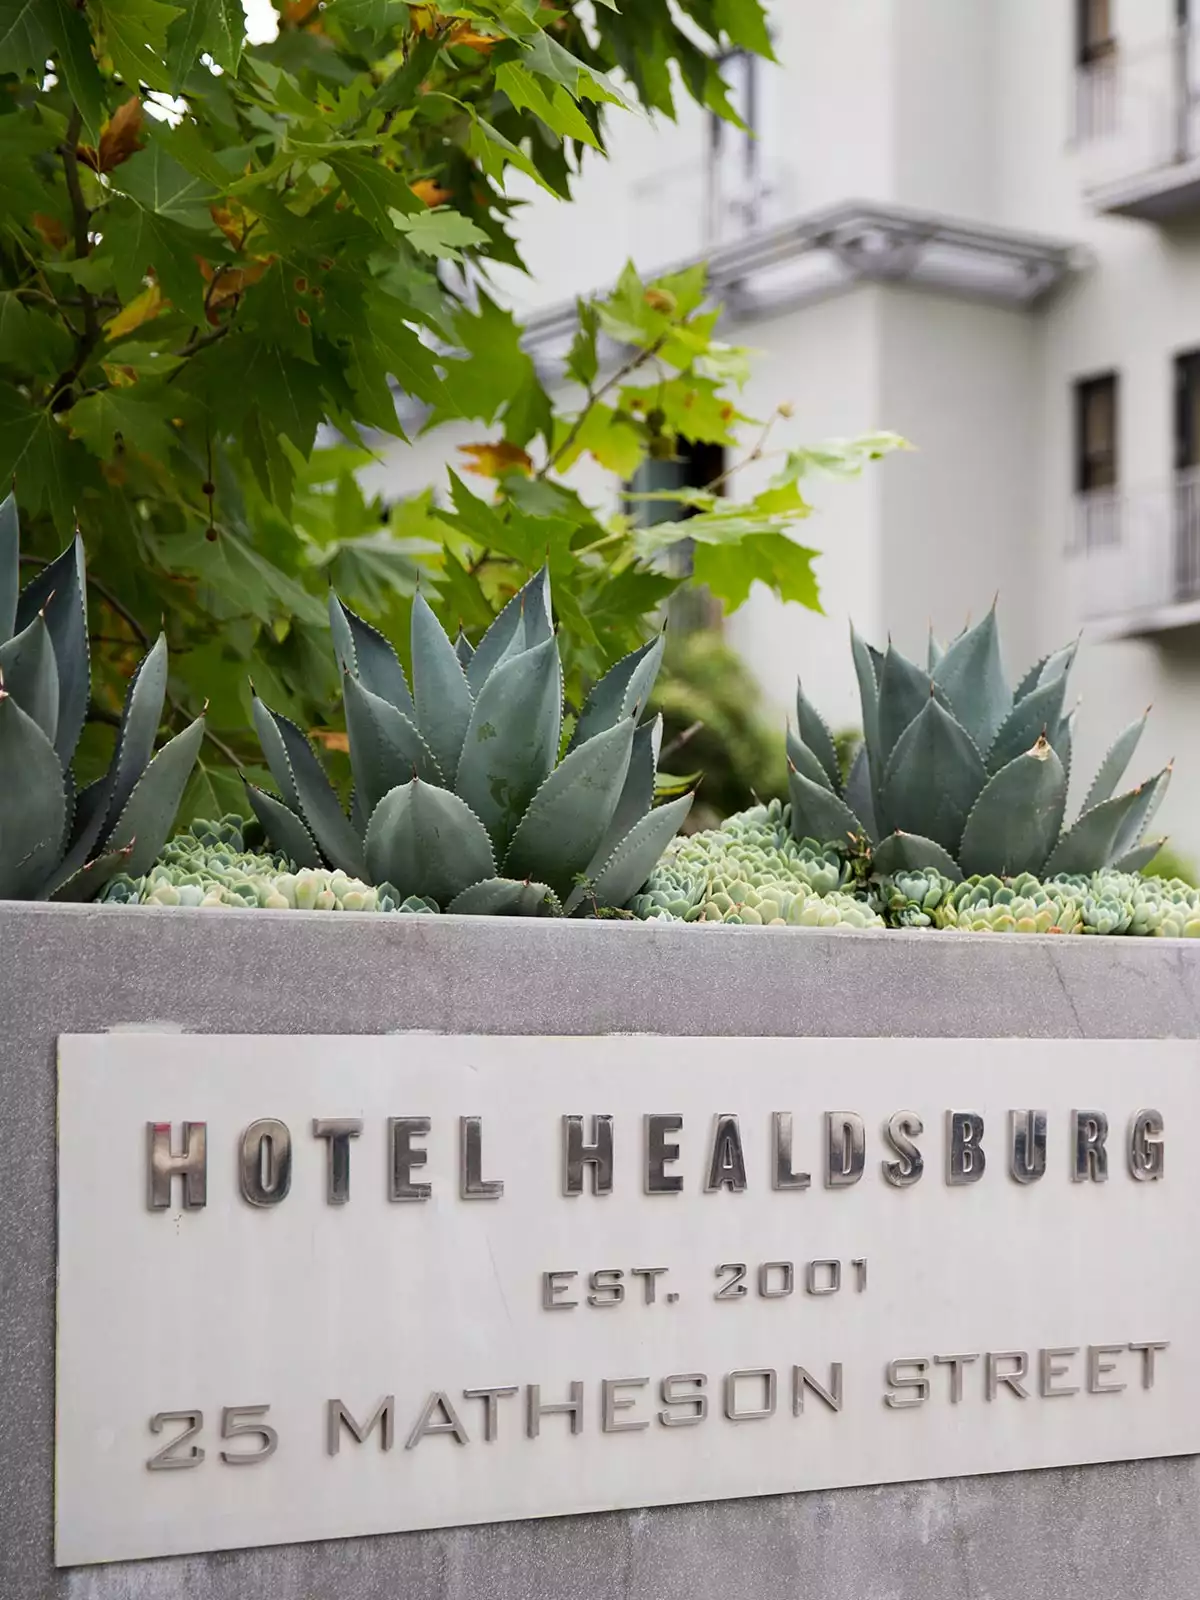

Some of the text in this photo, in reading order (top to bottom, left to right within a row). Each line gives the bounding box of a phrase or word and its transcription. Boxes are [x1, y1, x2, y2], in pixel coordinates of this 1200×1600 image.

[146, 1108, 1166, 1211] HOTEL HEALDSBURG
[542, 1256, 869, 1311] EST. 2001
[146, 1340, 1170, 1472] 25 MATHESON STREET
